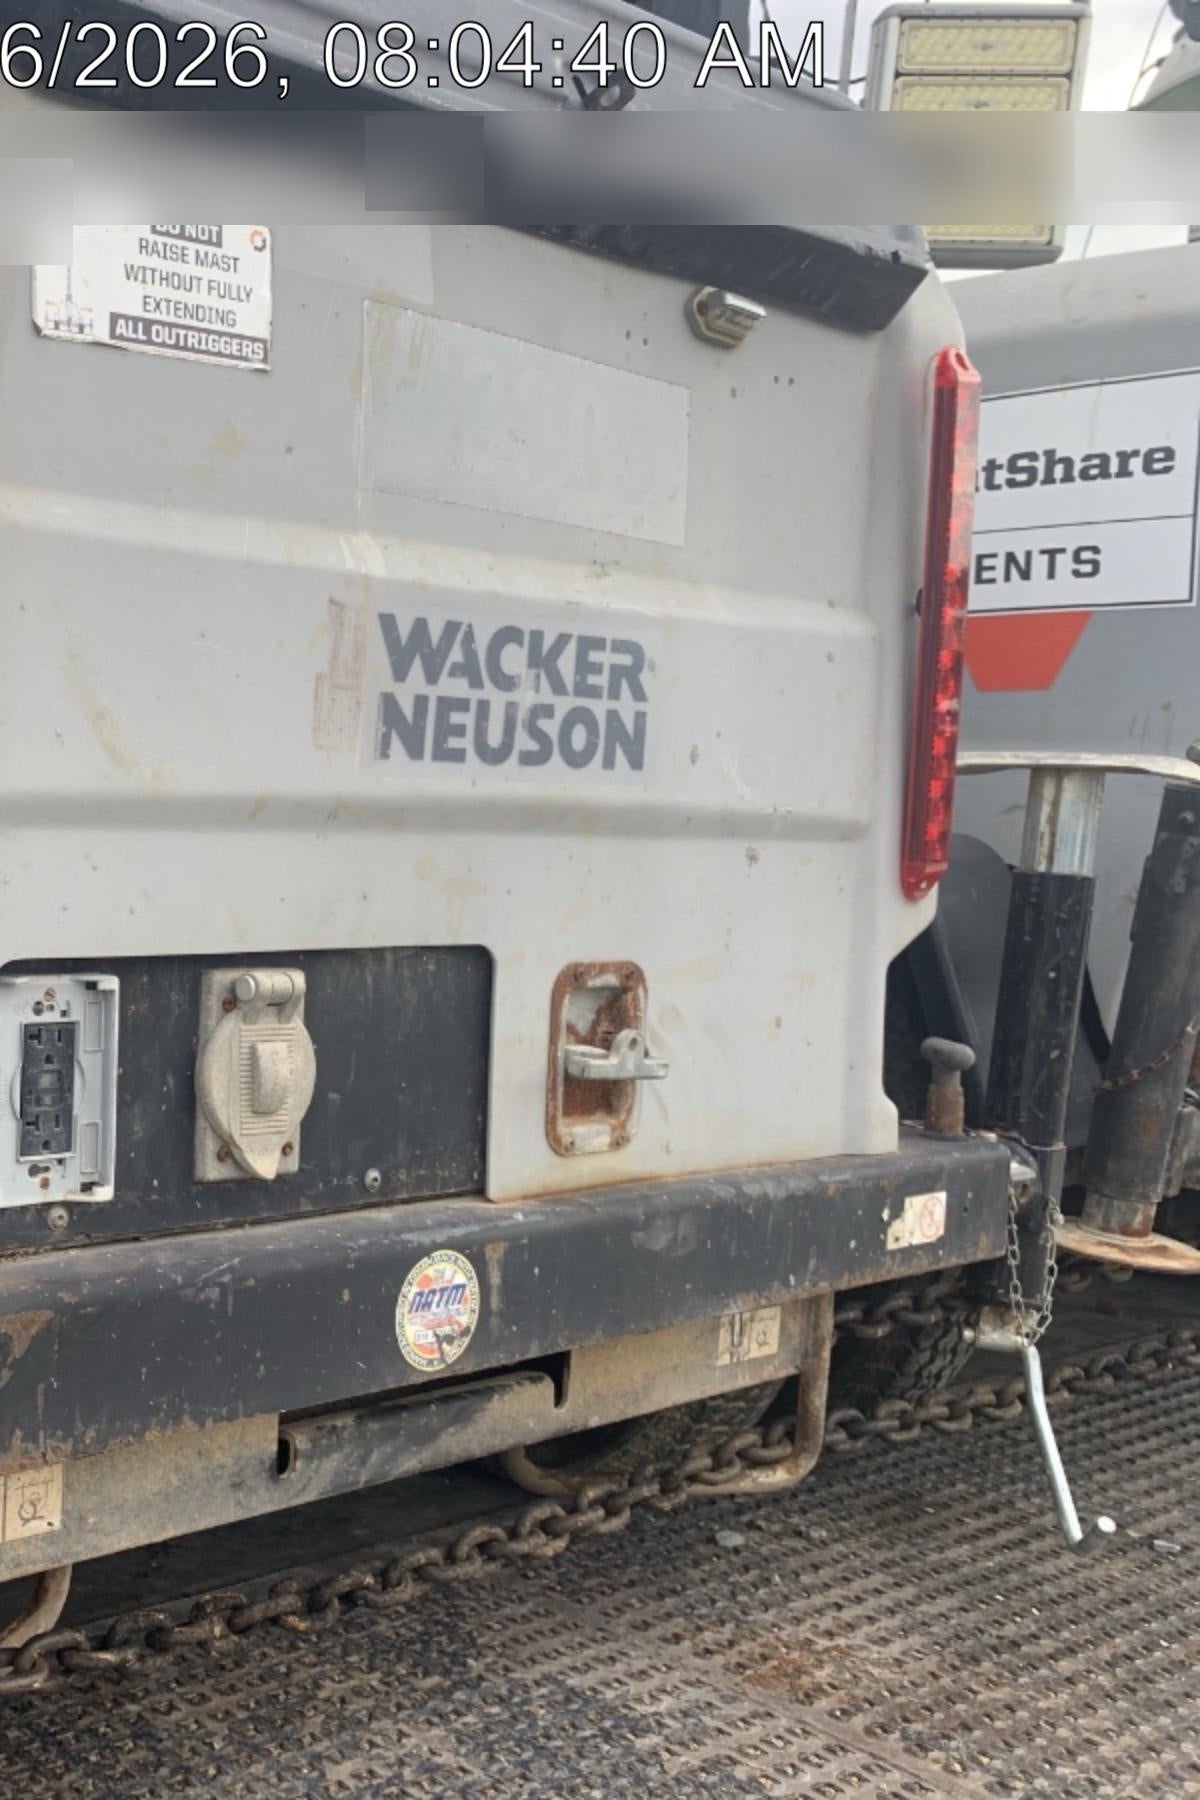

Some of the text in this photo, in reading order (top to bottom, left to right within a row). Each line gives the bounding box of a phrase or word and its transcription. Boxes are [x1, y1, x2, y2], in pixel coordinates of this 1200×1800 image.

[185, 225, 219, 243] NOT
[139, 238, 240, 274] RAISE MAST
[124, 263, 253, 303] WITHOUT FULLY
[143, 295, 237, 328] EXTENDING
[116, 319, 266, 361] ALL OUTRIGGERS
[975, 446, 1176, 492] tShare
[974, 546, 1102, 585] ENTS
[378, 613, 649, 702] WACKER
[375, 692, 647, 771] NEUSON
